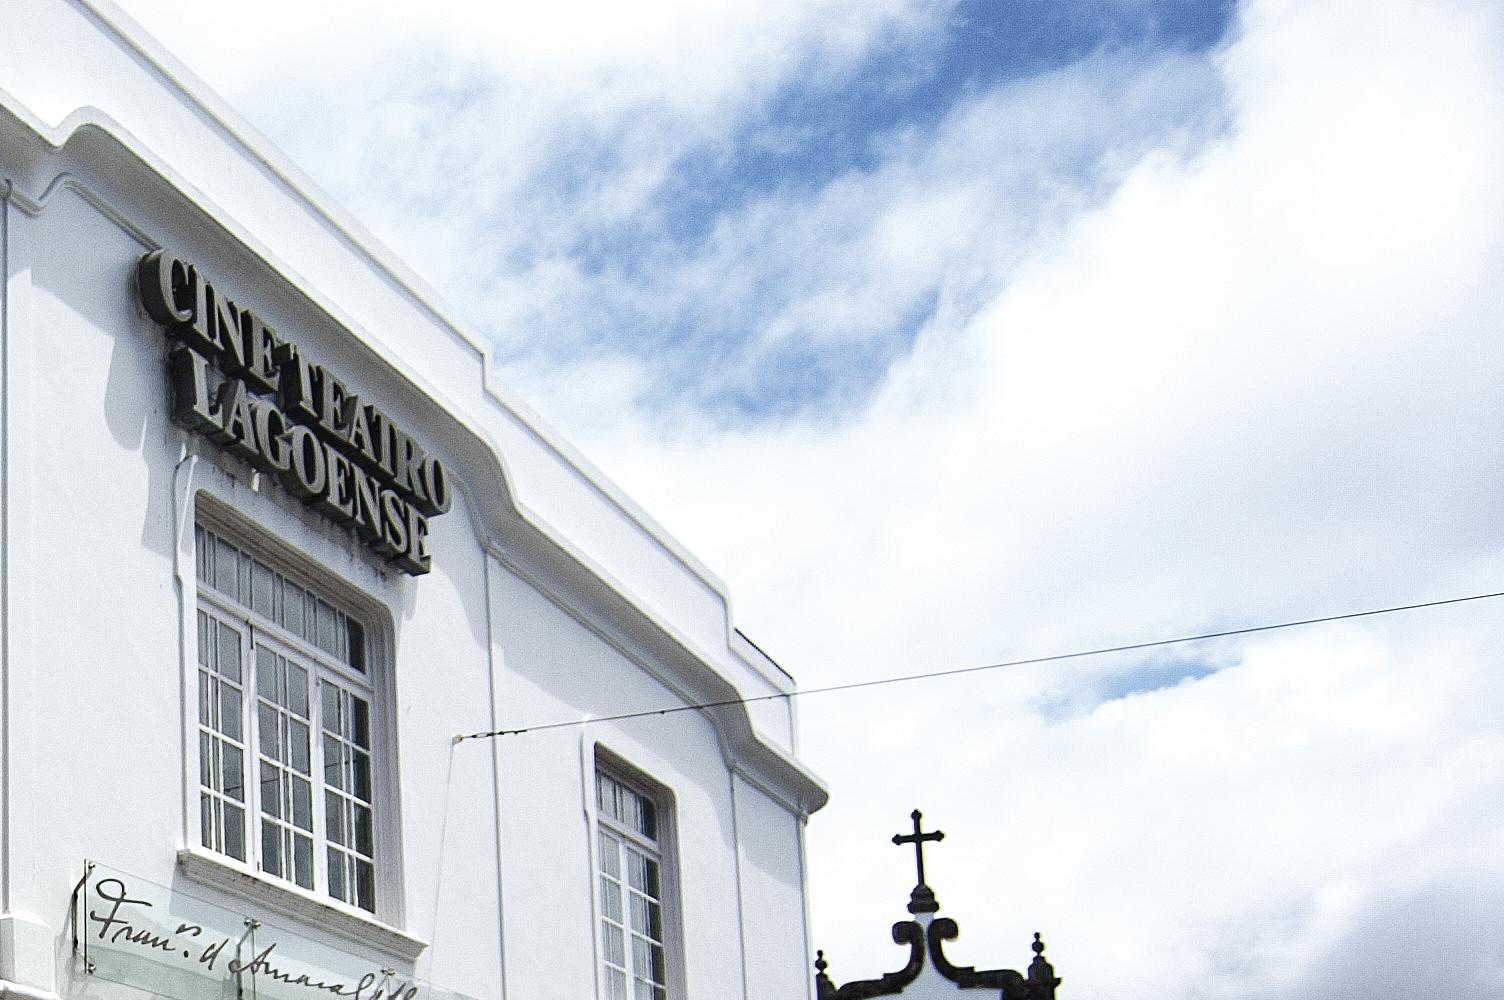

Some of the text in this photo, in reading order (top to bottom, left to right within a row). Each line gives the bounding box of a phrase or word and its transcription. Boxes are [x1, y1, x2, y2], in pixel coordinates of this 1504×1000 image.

[140, 250, 451, 516] CINE TEATRO
[172, 346, 432, 576] LAGOENSE
